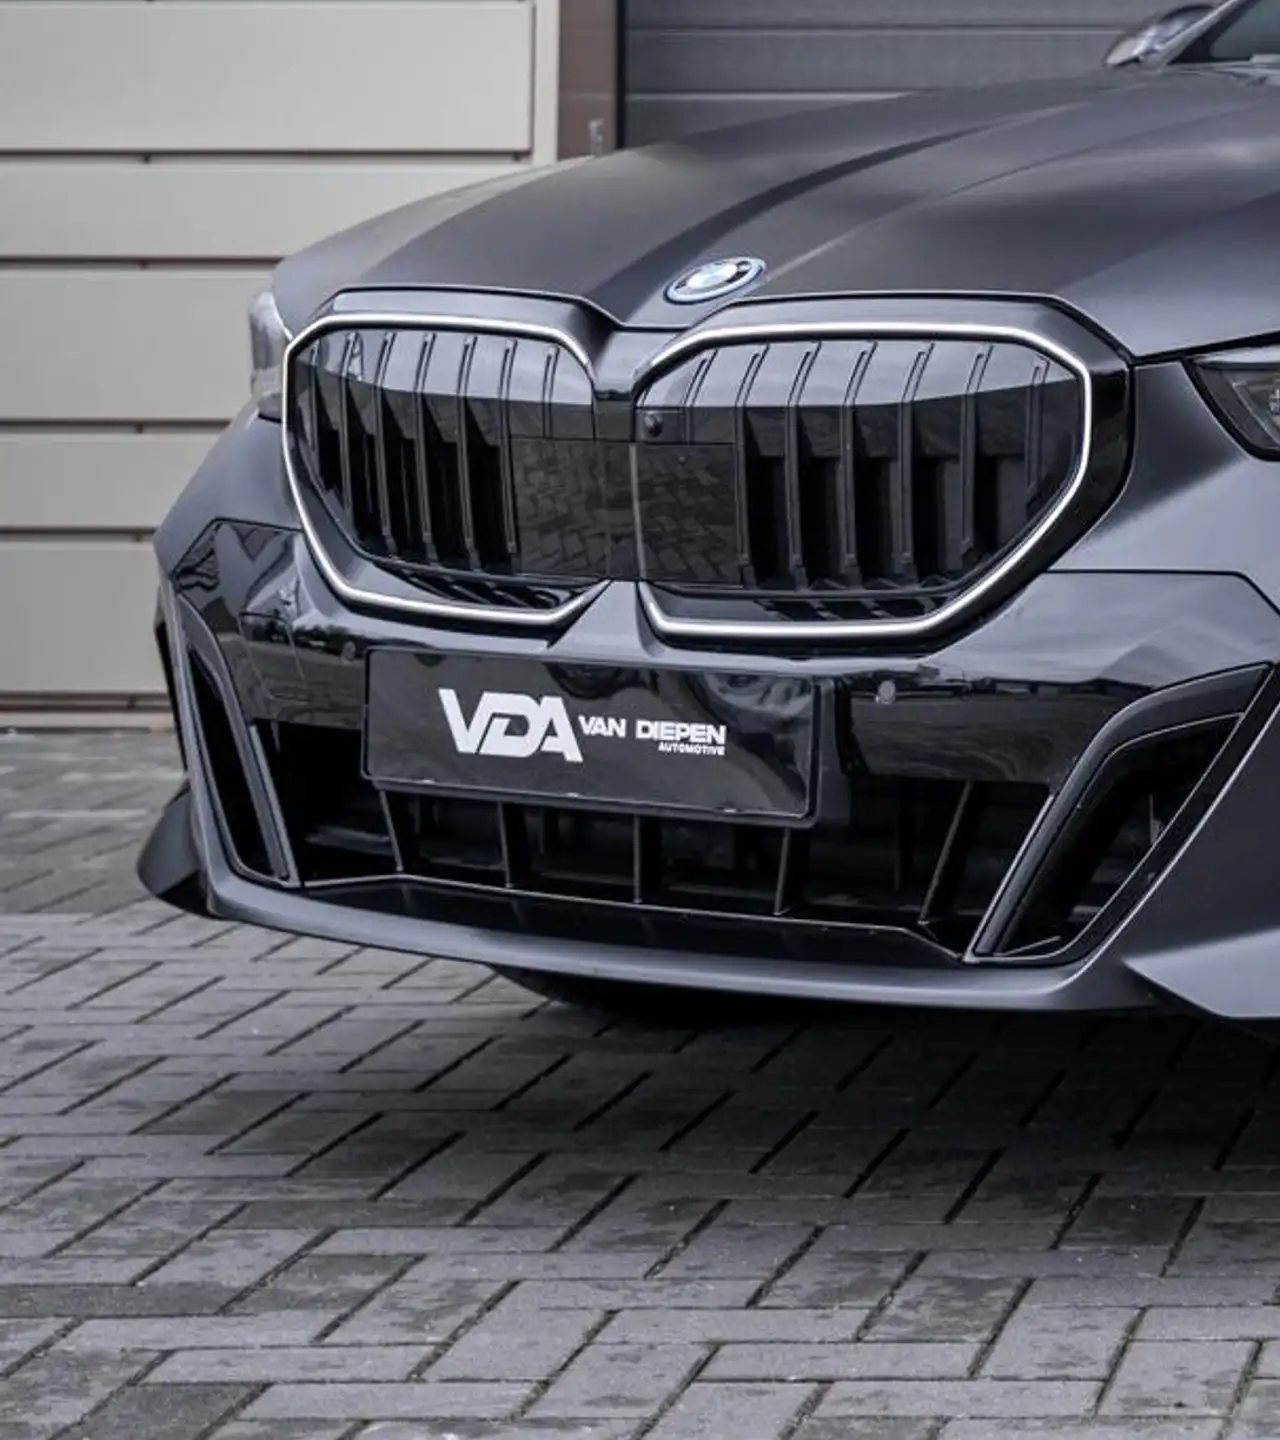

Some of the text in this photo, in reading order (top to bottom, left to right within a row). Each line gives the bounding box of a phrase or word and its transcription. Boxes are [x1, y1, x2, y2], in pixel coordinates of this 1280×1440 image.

[438, 687, 583, 763] VDA
[578, 714, 727, 745] VAN DIEPEN
[658, 741, 726, 756] AUTOMOTIVE
